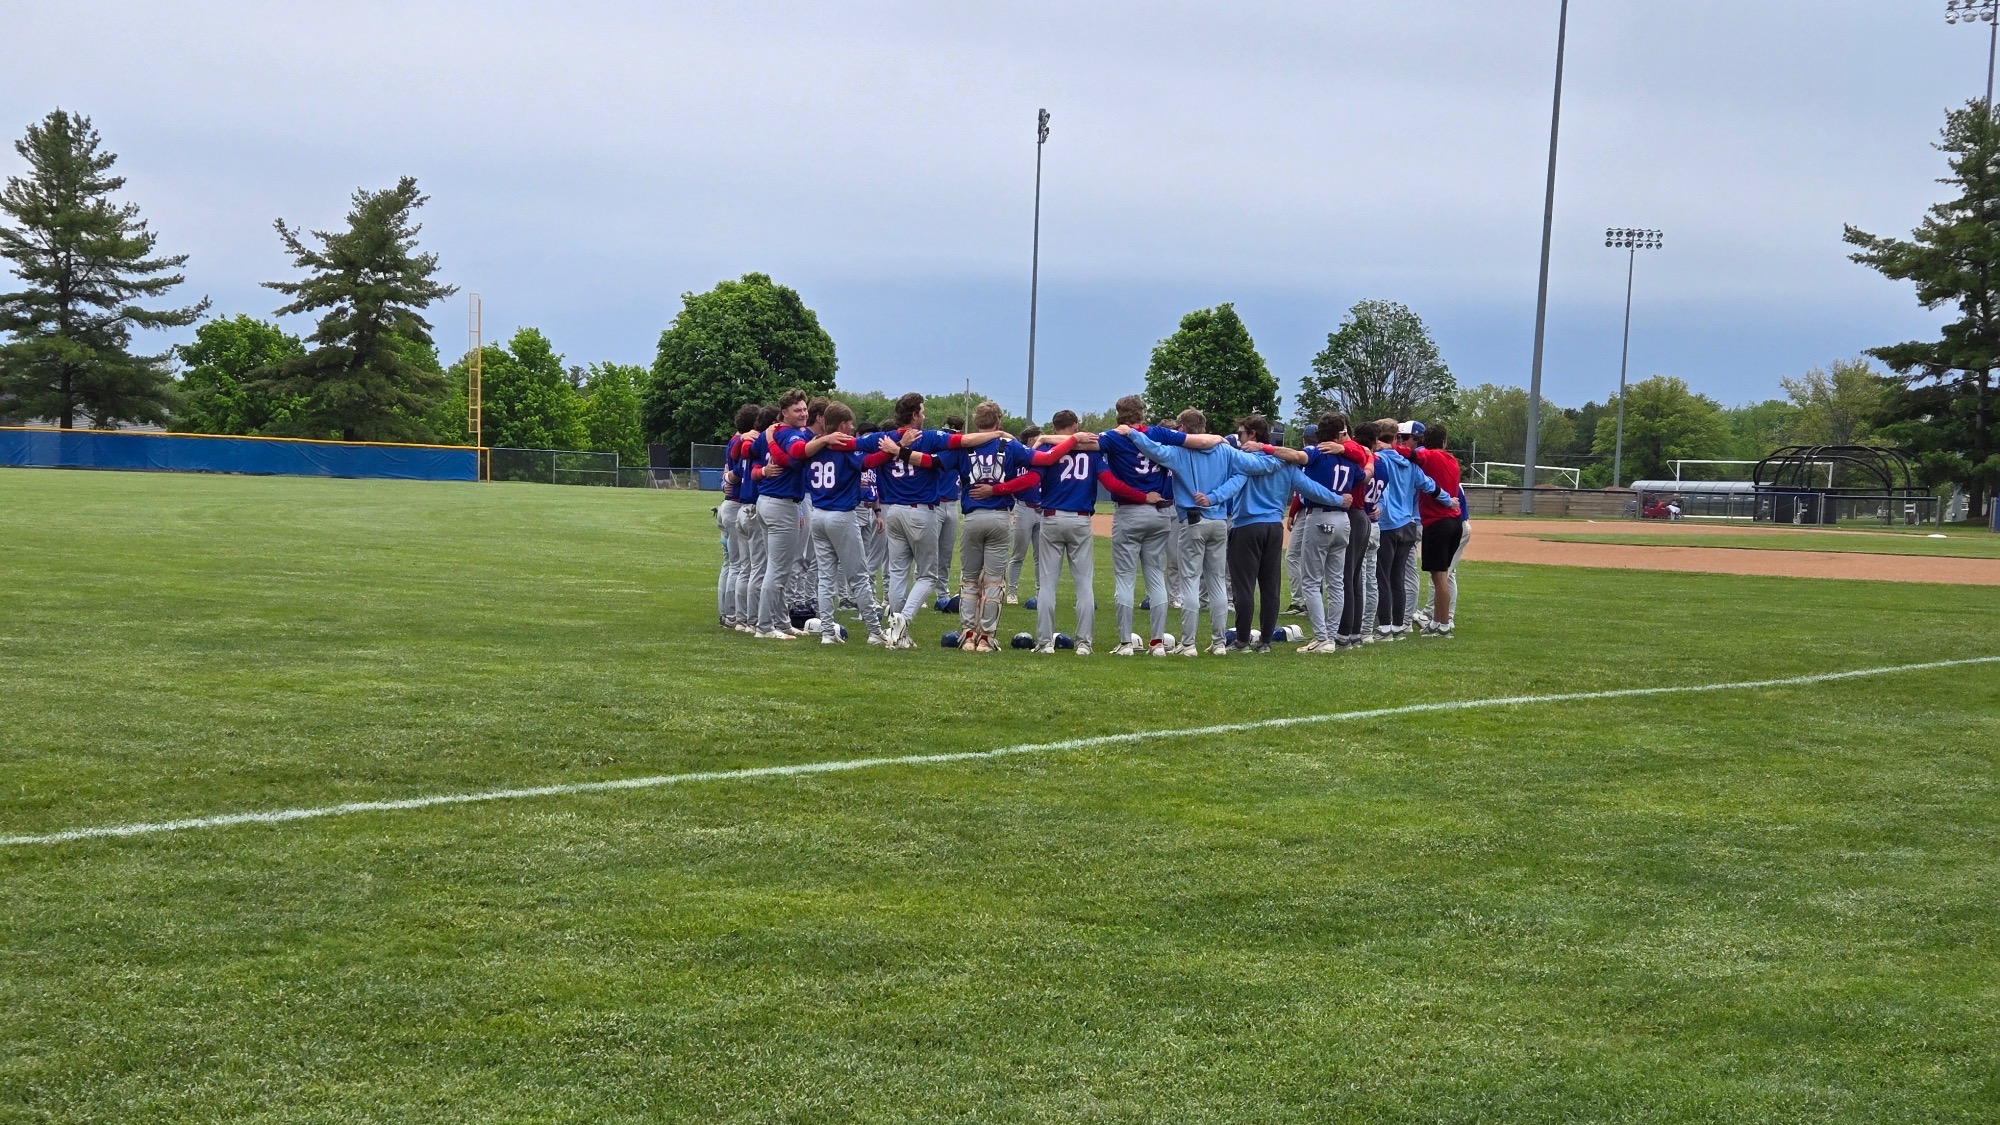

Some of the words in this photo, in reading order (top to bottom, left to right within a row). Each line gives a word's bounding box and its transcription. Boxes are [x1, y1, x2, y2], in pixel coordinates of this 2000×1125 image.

[810, 461, 836, 489] 38
[1060, 453, 1090, 482] 20
[1332, 464, 1350, 491] 17
[1364, 477, 1384, 503] 26
